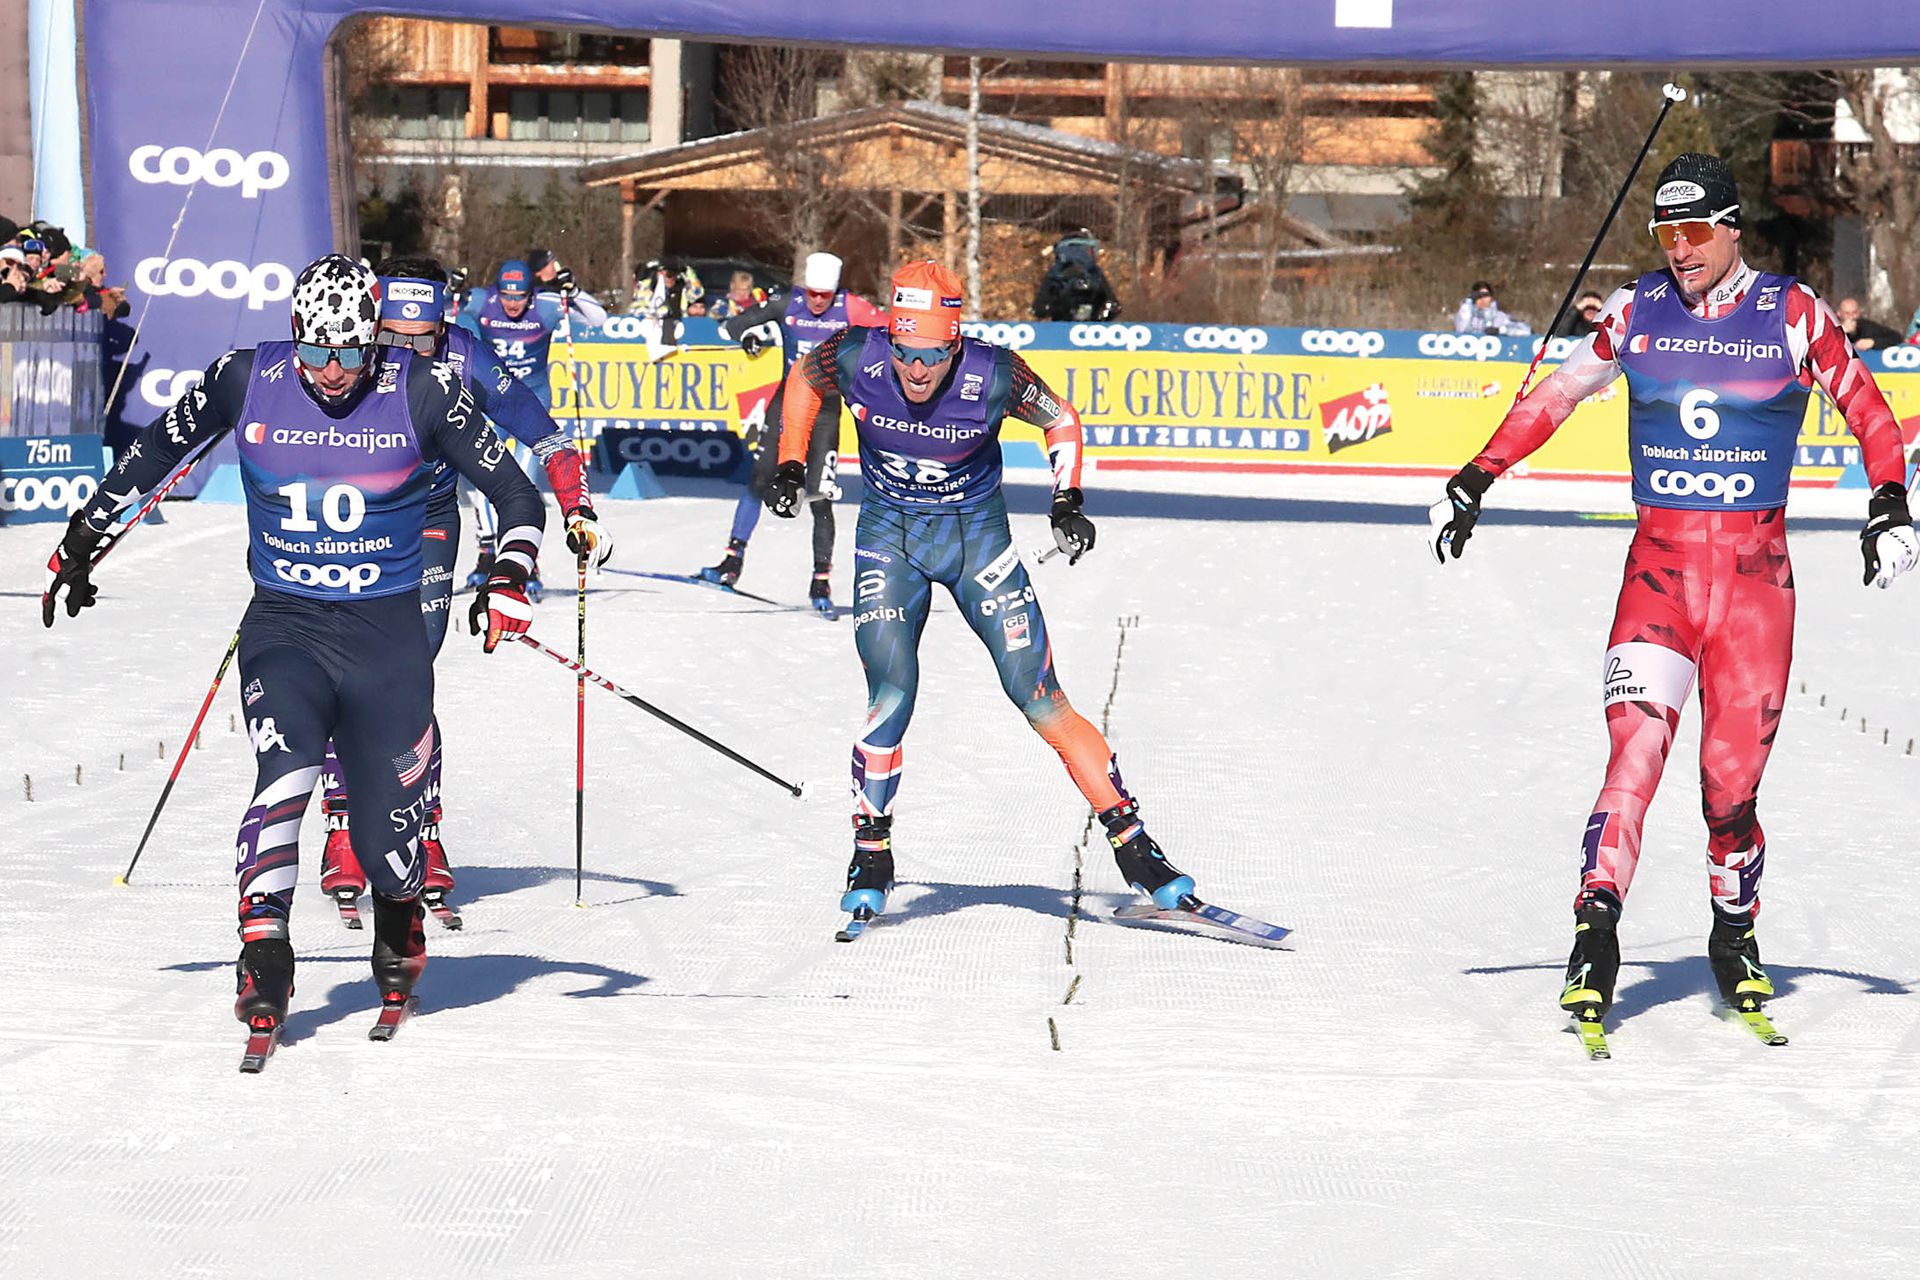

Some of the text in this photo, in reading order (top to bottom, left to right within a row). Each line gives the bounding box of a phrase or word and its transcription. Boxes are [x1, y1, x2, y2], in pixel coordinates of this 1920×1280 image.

[129, 145, 289, 198] coop
[134, 257, 295, 310] coop
[492, 338, 526, 359] 34
[1069, 324, 1151, 351] coop
[1184, 327, 1268, 354] coop
[1301, 330, 1384, 357] coop
[1418, 333, 1501, 360] coop
[1656, 336, 1783, 362] azerbaijan
[1882, 346, 1920, 368] co
[141, 369, 206, 407] co
[1066, 362, 1313, 420] LE GRUYÈRE
[1323, 404, 1392, 444] AOP
[1680, 389, 1720, 440] 6
[26, 440, 71, 464] 75m
[273, 427, 406, 454] azerbaijan
[618, 437, 730, 469] coop
[1642, 444, 1689, 460] Toblach
[0, 475, 98, 516] coop
[1650, 469, 1755, 503] coop
[278, 482, 366, 533] 10
[262, 532, 310, 554] Toblach
[273, 558, 381, 594] coop
[1006, 615, 1026, 628] GB
